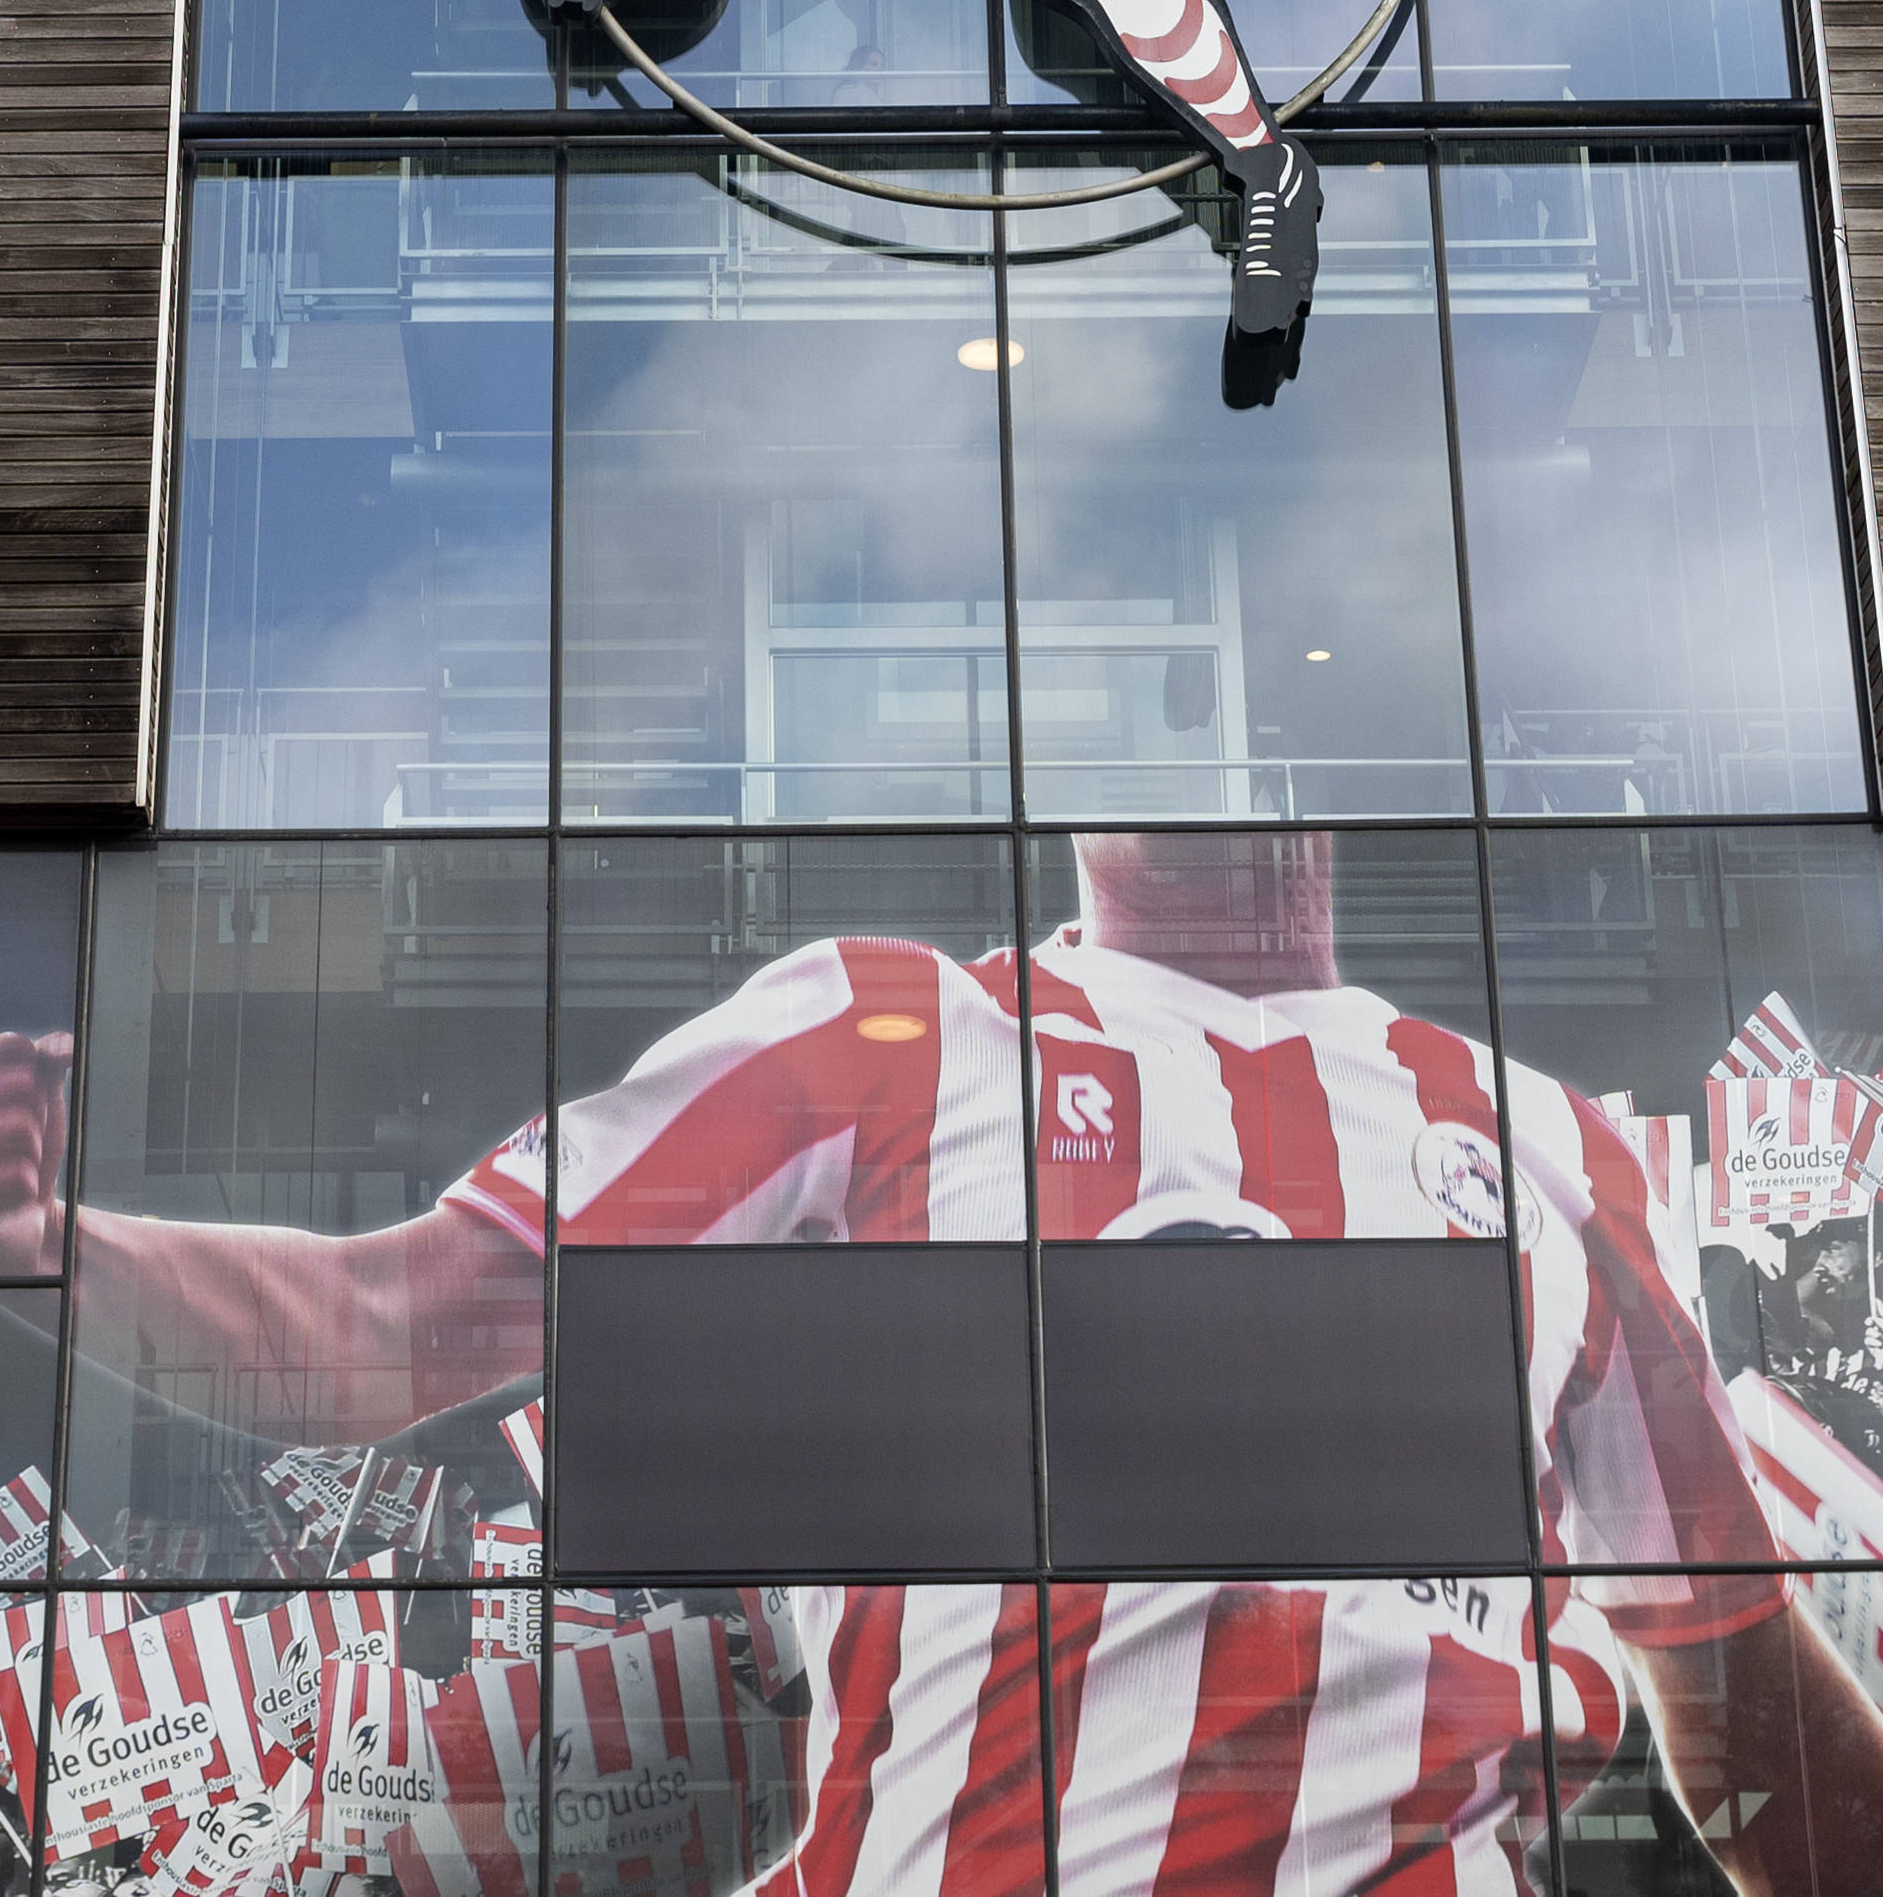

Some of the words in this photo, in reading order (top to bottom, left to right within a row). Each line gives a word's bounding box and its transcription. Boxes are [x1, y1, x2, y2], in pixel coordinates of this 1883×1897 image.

[1731, 1149, 1757, 1173] de
[1762, 1144, 1846, 1171] Goudse
[1744, 1173, 1837, 1189] verzekeringen
[310, 1466, 353, 1507] Goud
[374, 1491, 418, 1520] udse
[507, 1558, 522, 1648] verkeringen
[341, 1637, 385, 1662] dse
[260, 1687, 293, 1715] de
[47, 1751, 80, 1785] de
[87, 1710, 209, 1769] Goudse
[68, 1746, 205, 1801] verzekeringen
[327, 1760, 353, 1795] de
[358, 1764, 436, 1804] Gouds
[554, 1766, 689, 1828] Goudse
[45, 1814, 111, 1846] nthousiaste
[196, 1806, 226, 1845] de
[338, 1805, 418, 1825] verzekerin
